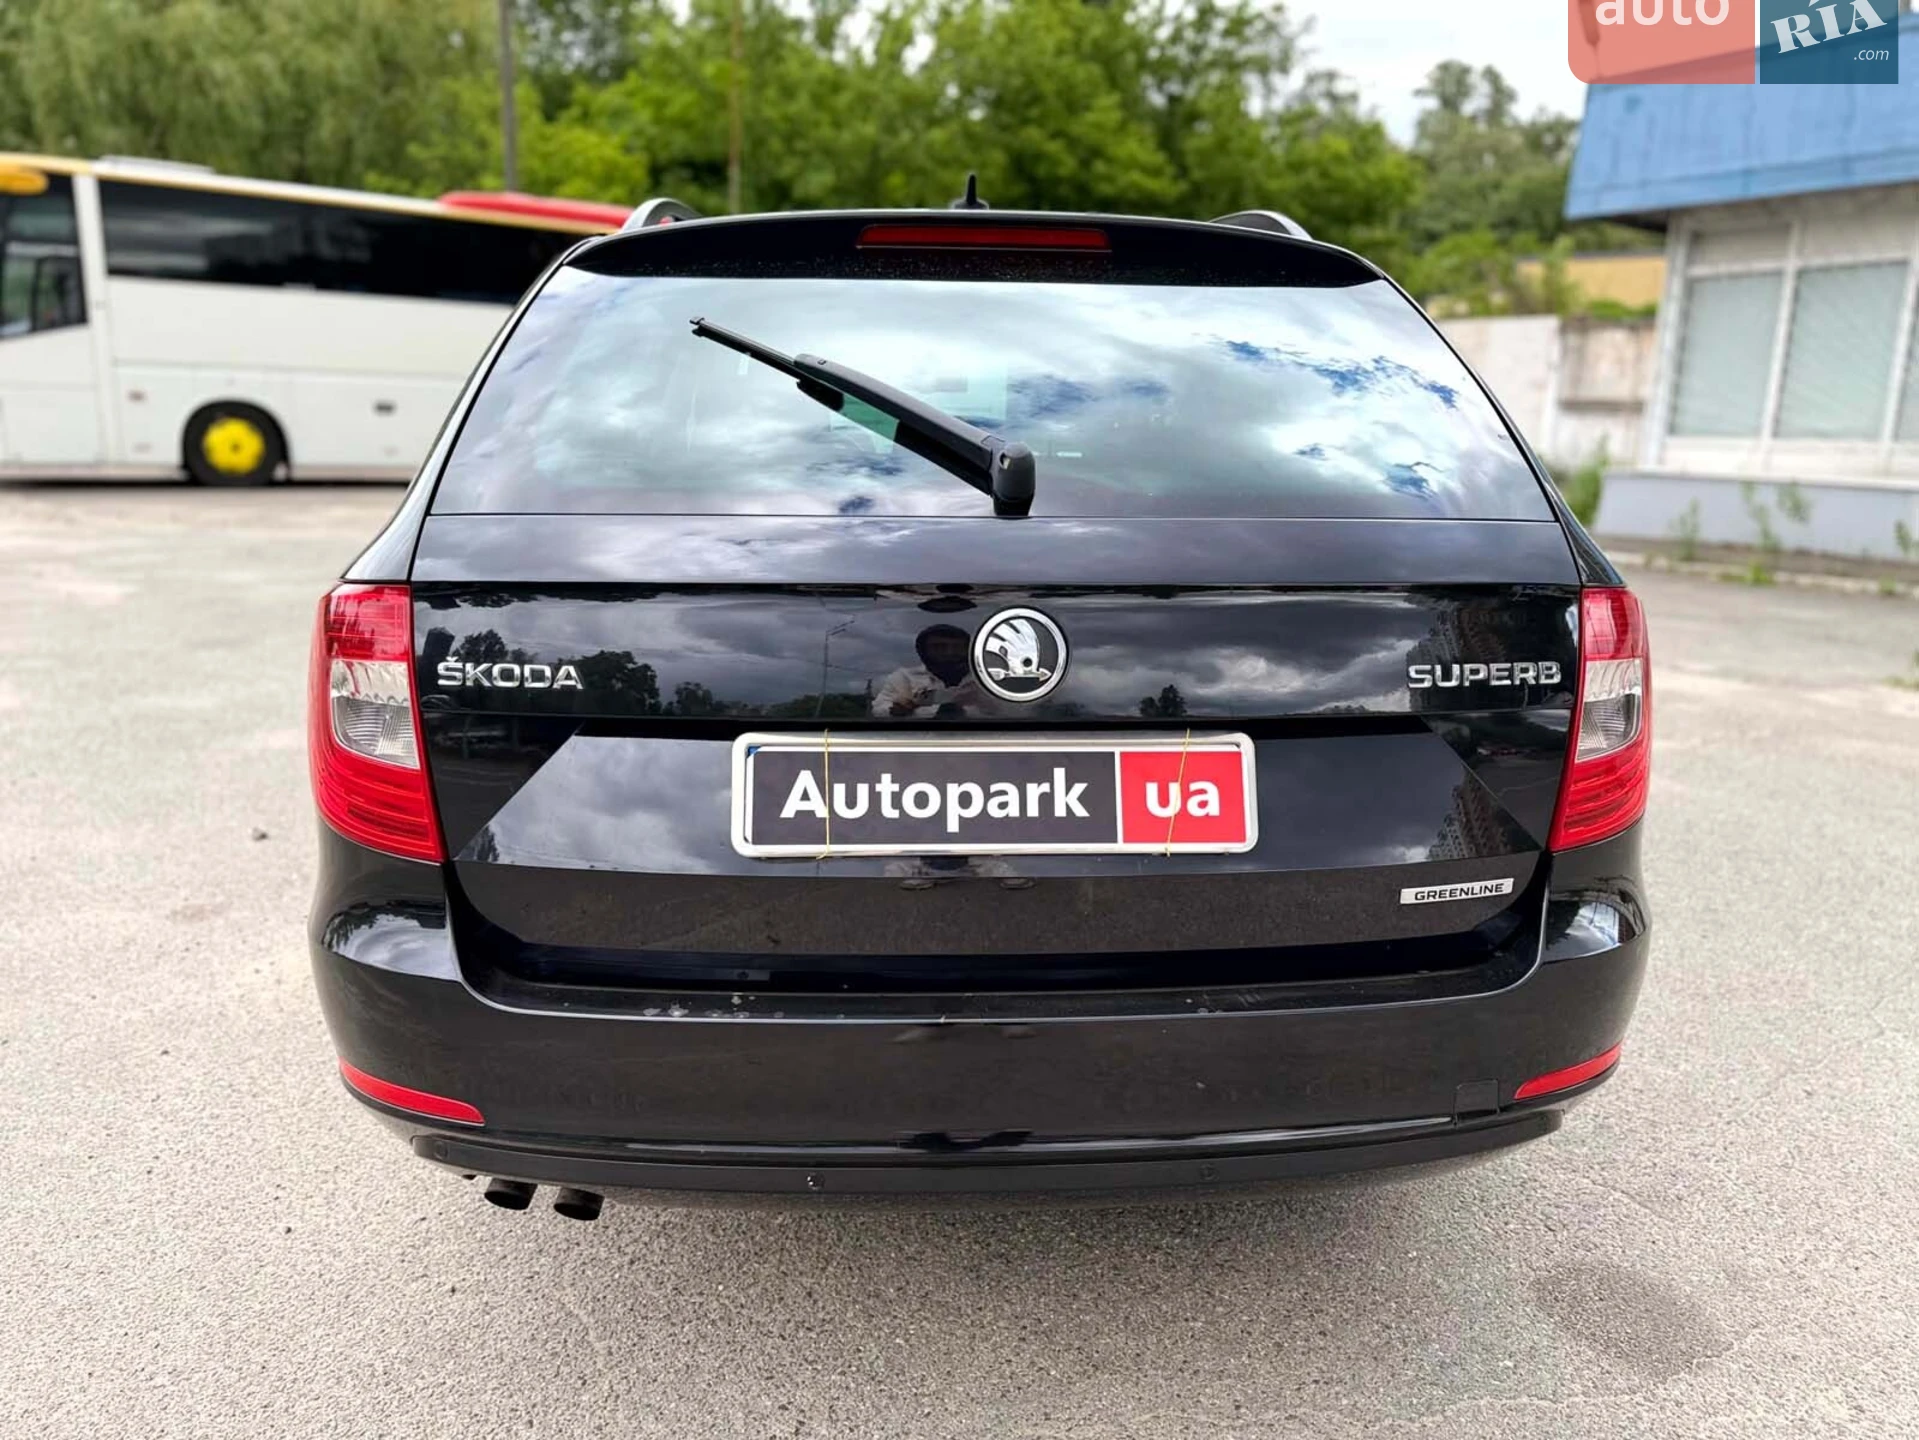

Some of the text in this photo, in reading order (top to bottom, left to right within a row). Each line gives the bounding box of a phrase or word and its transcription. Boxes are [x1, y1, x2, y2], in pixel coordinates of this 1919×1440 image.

[436, 656, 585, 690] ŠKODA
[1408, 660, 1562, 689] SUPERB
[779, 766, 1221, 834] Autopark ua
[1414, 882, 1505, 902] GREENLINE
